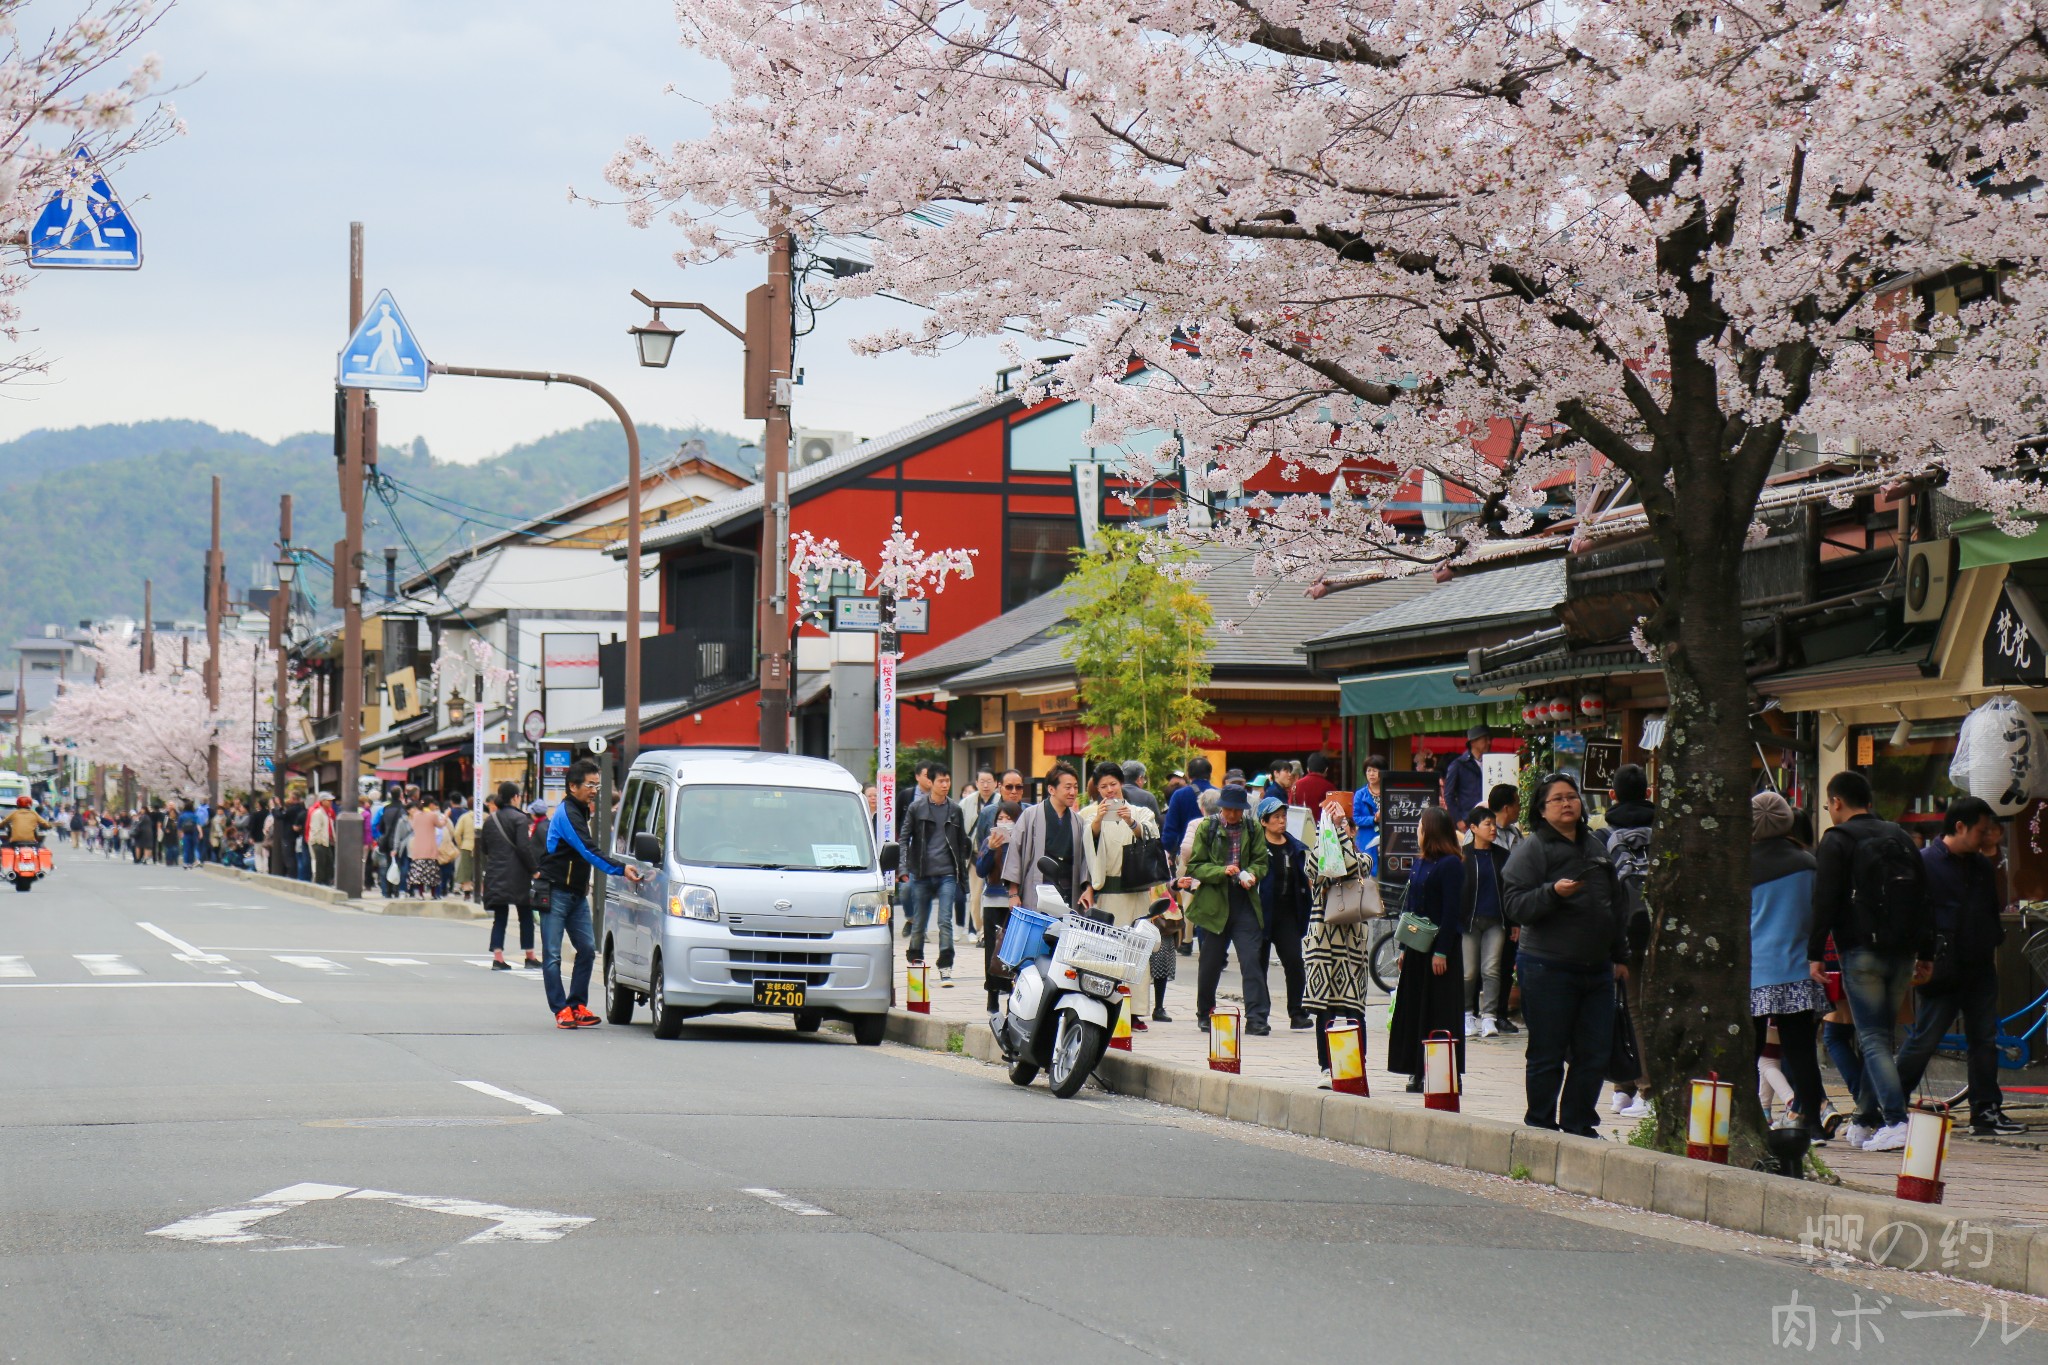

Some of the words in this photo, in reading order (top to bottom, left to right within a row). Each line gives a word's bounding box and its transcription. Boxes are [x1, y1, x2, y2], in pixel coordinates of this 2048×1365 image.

[882, 666, 893, 702] 桜まつり
[1999, 716, 2032, 806] うどん
[883, 784, 893, 823] 桜まつり
[1399, 800, 1416, 808] カフェ
[764, 991, 803, 1007] 72-00
